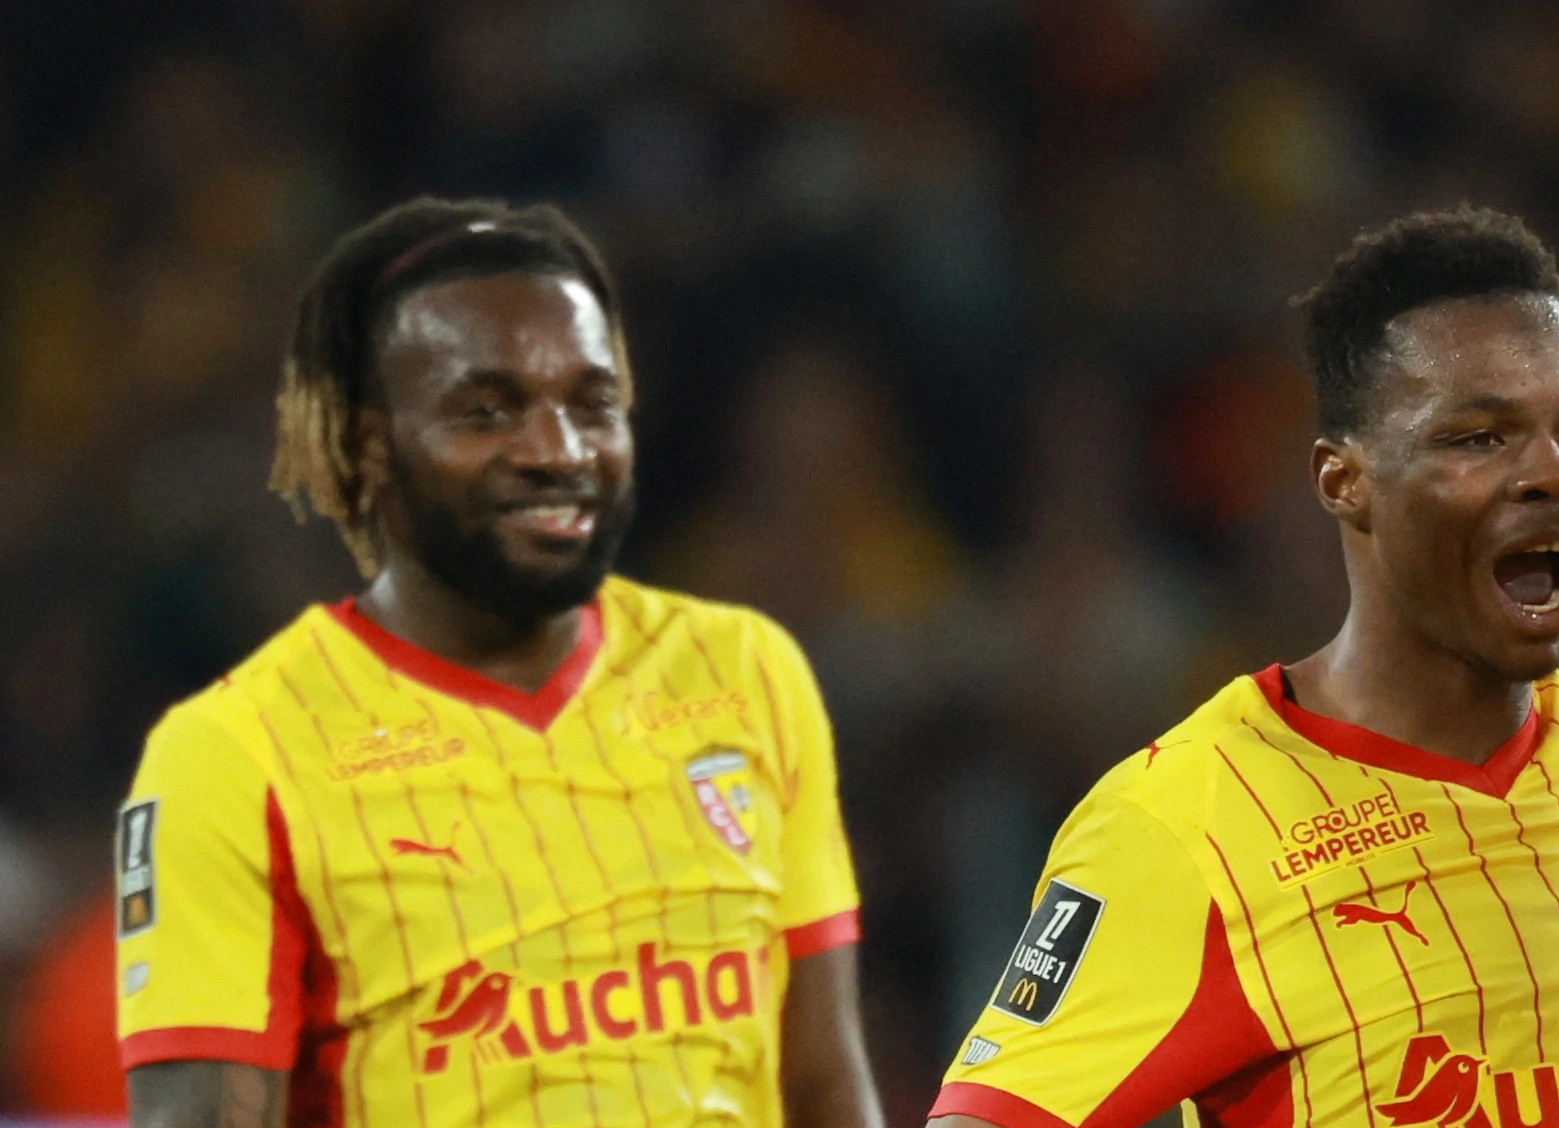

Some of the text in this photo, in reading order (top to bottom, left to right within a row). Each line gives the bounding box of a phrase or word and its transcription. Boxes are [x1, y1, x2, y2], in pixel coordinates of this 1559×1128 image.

[1290, 793, 1395, 845] GROUPE
[1271, 811, 1432, 883] LEMPEREUR
[1014, 944, 1067, 984] LIGUE 1
